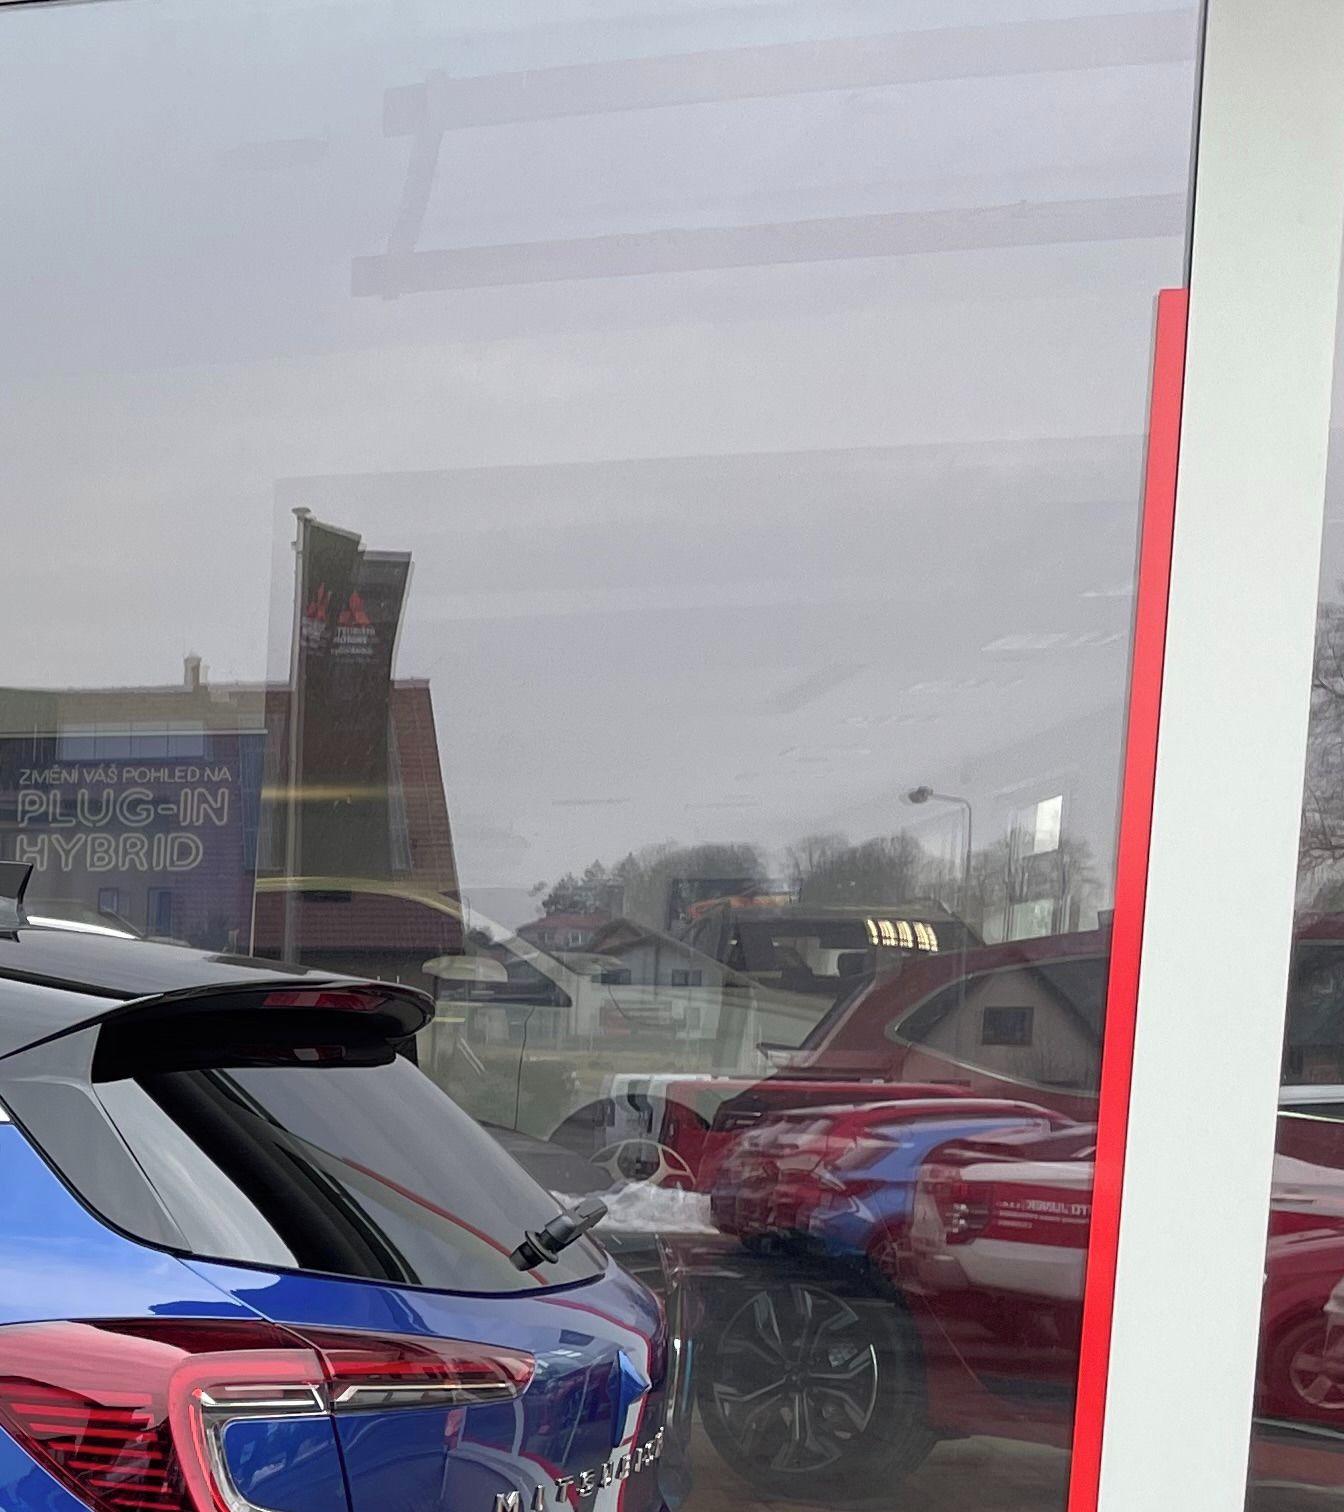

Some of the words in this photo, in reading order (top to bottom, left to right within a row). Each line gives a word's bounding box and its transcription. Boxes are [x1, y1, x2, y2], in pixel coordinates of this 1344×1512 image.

[19, 764, 78, 785] ZMĚNÍ
[83, 763, 118, 783] VÁŠ
[123, 767, 200, 783] POHLED
[204, 767, 232, 782] NA
[17, 787, 229, 827] PLUG-IN
[16, 832, 203, 872] HYBRID
